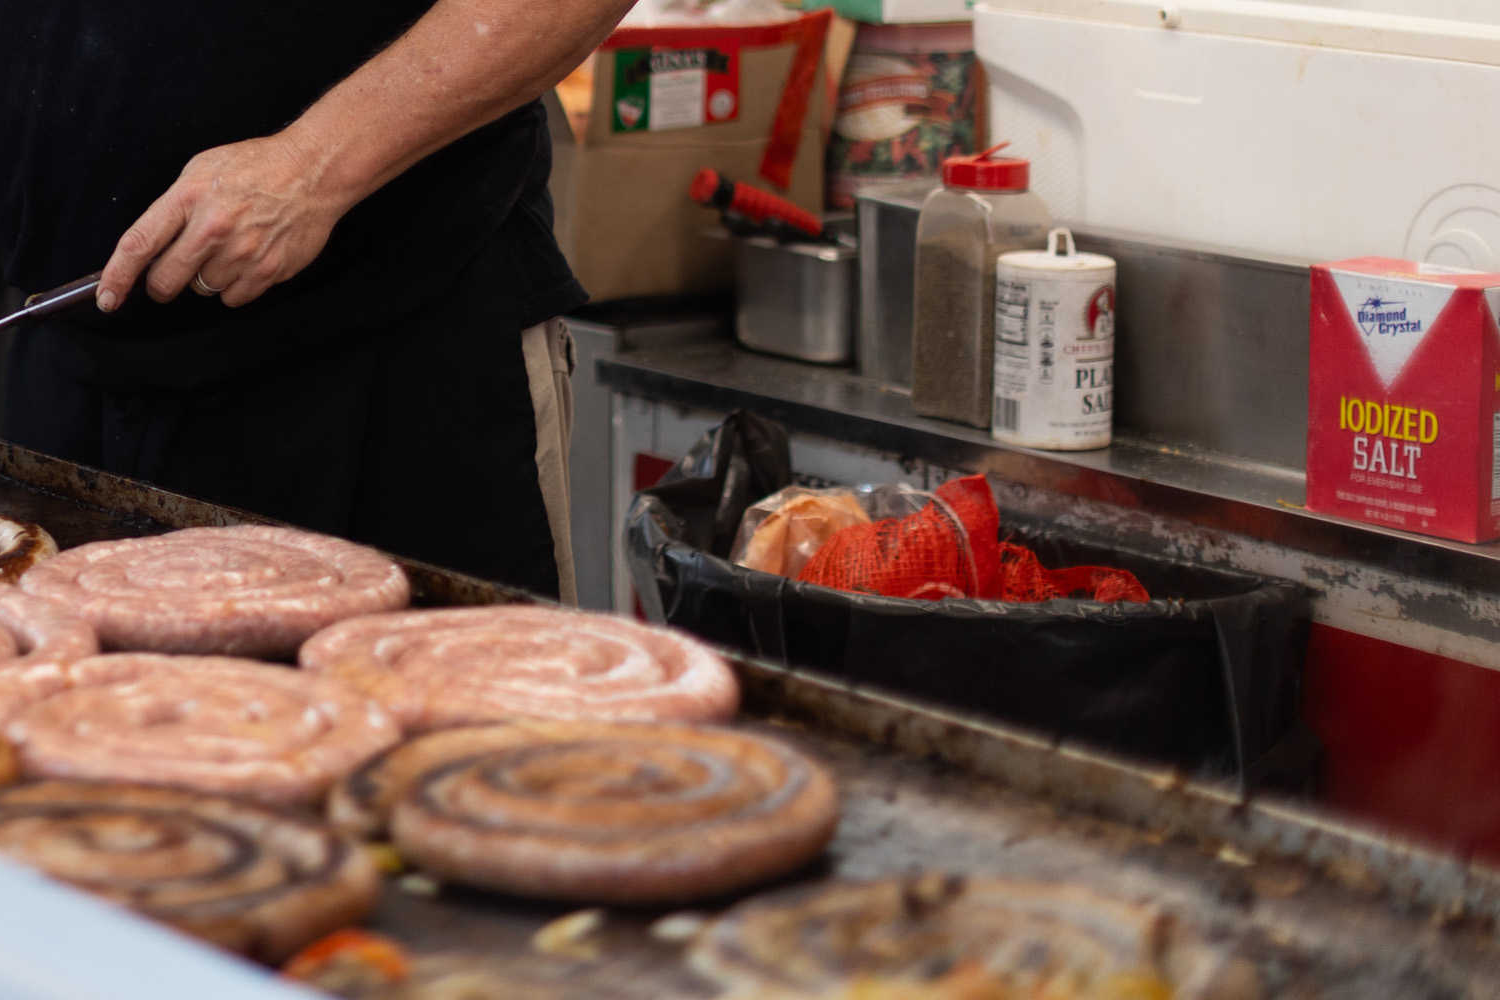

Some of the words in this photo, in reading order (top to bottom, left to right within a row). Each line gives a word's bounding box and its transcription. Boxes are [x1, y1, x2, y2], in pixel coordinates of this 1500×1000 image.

[1358, 307, 1406, 324] Diamond
[1379, 320, 1421, 337] Crystal
[1340, 396, 1438, 444] IODIZED
[1353, 436, 1422, 480] SALT
[1351, 473, 1366, 484] FOR
[1407, 482, 1423, 495] USE
